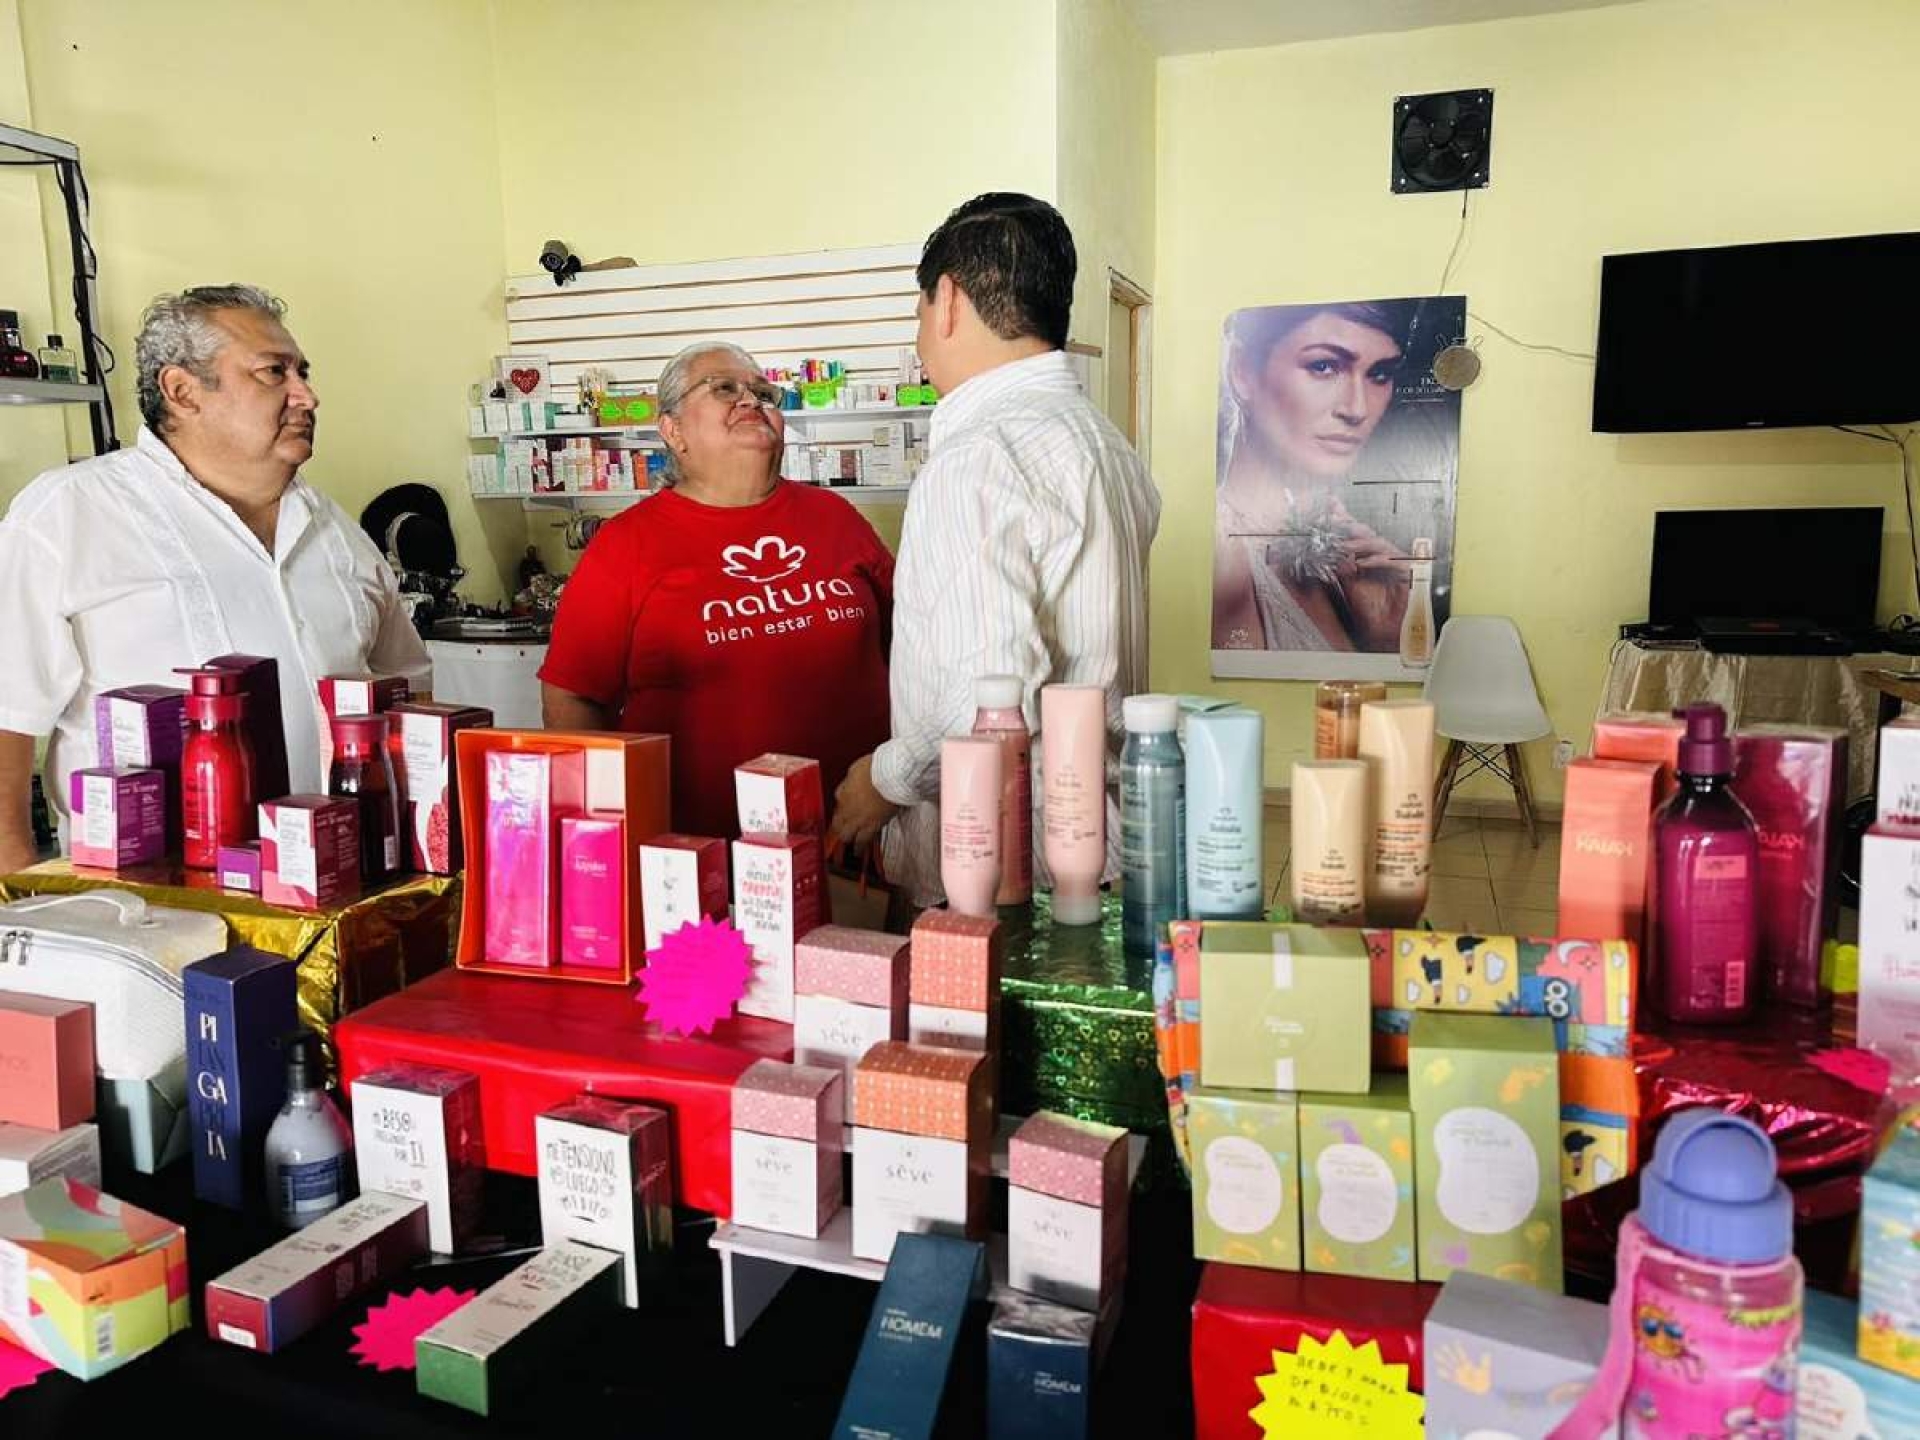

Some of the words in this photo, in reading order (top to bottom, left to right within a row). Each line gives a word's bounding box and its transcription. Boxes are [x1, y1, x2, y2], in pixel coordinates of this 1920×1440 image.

[703, 578, 854, 621] natura
[705, 626, 754, 644] bien
[764, 615, 814, 635] estar
[826, 606, 865, 622] bien
[880, 1315, 943, 1340] HOMEM
